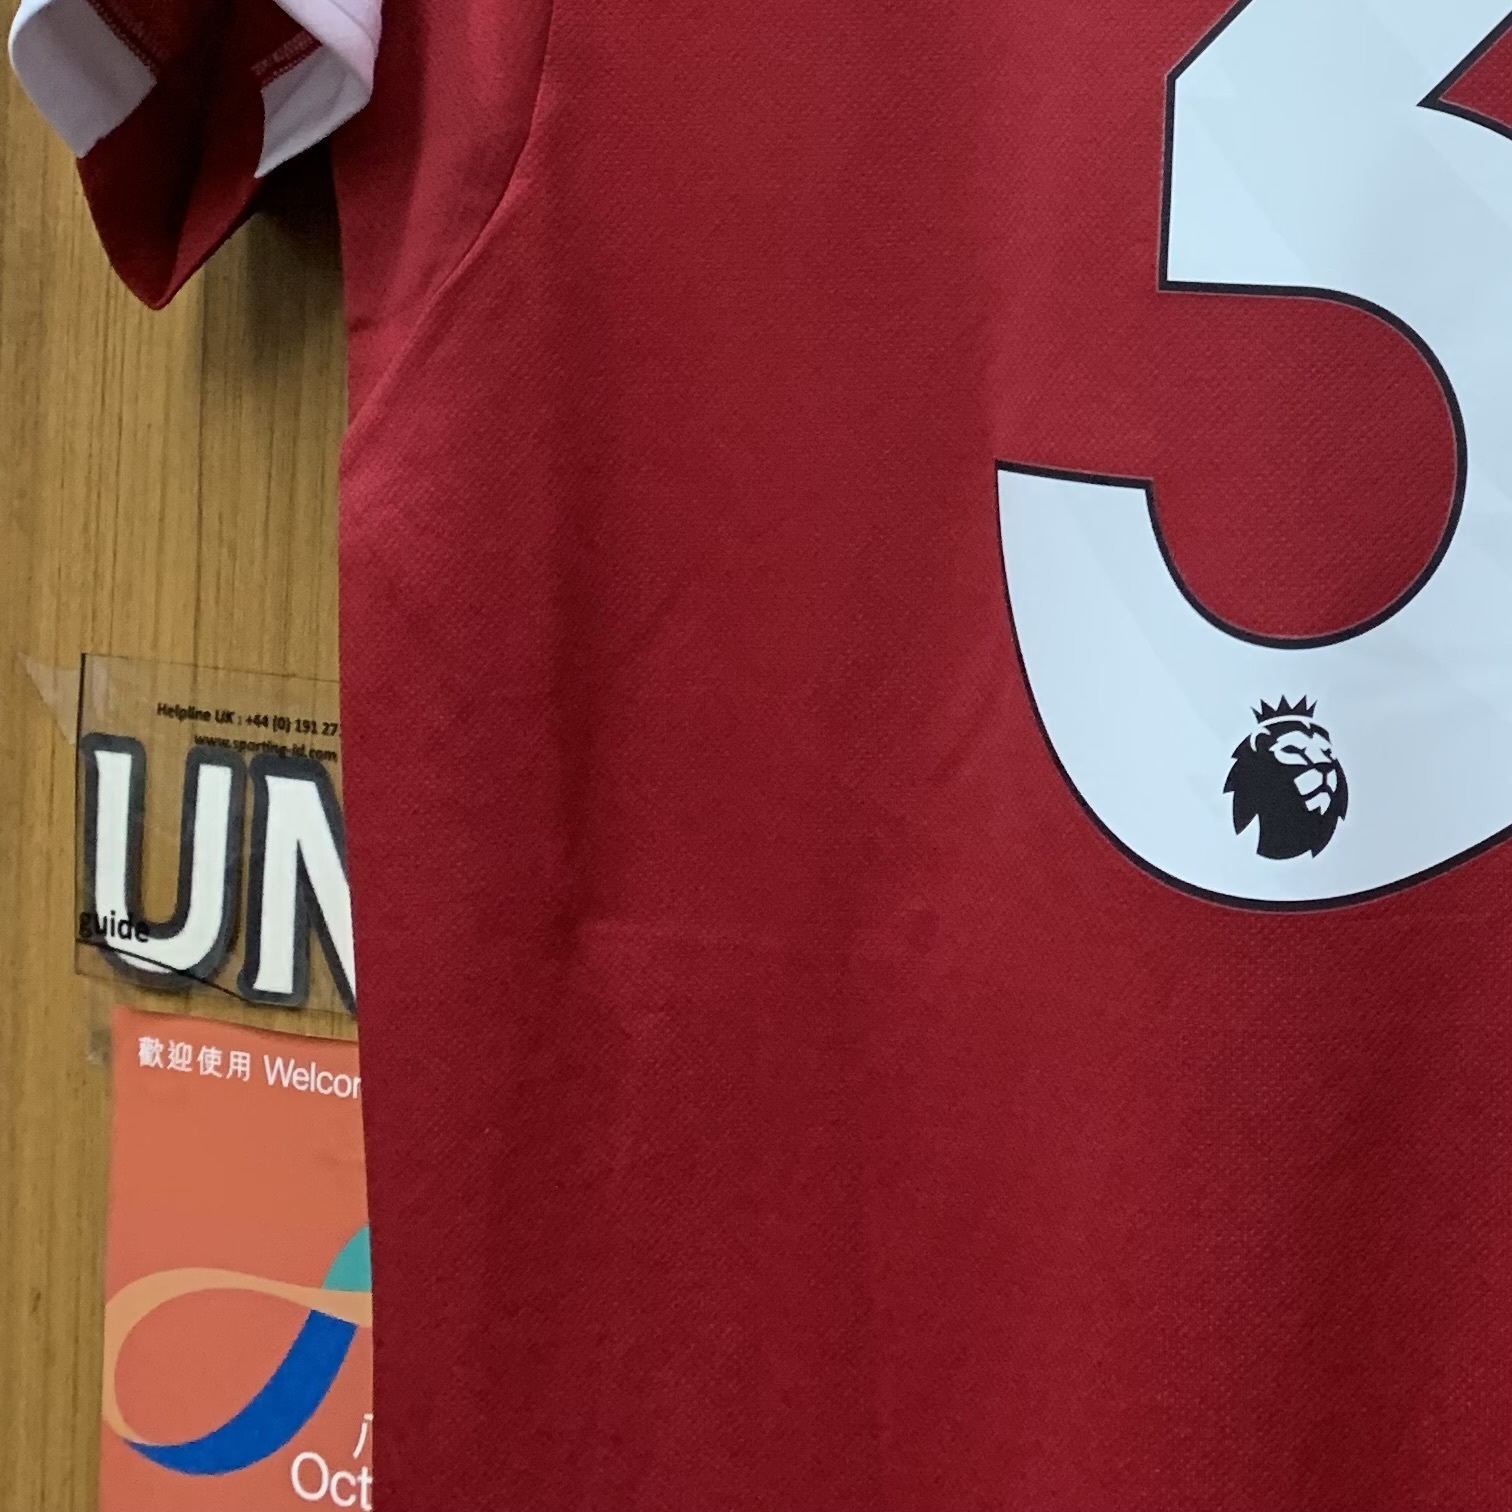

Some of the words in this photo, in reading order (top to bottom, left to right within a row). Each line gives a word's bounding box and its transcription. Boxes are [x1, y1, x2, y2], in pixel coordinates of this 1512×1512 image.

[157, 702, 212, 724] Helpline
[214, 709, 236, 725] UK
[245, 714, 269, 729] +44
[272, 715, 291, 734] (0)
[294, 718, 318, 736] 191
[322, 721, 341, 738] 27
[79, 909, 150, 943] guide
[137, 1036, 252, 1082] 歡迎使用
[290, 1451, 373, 1510] Oct
